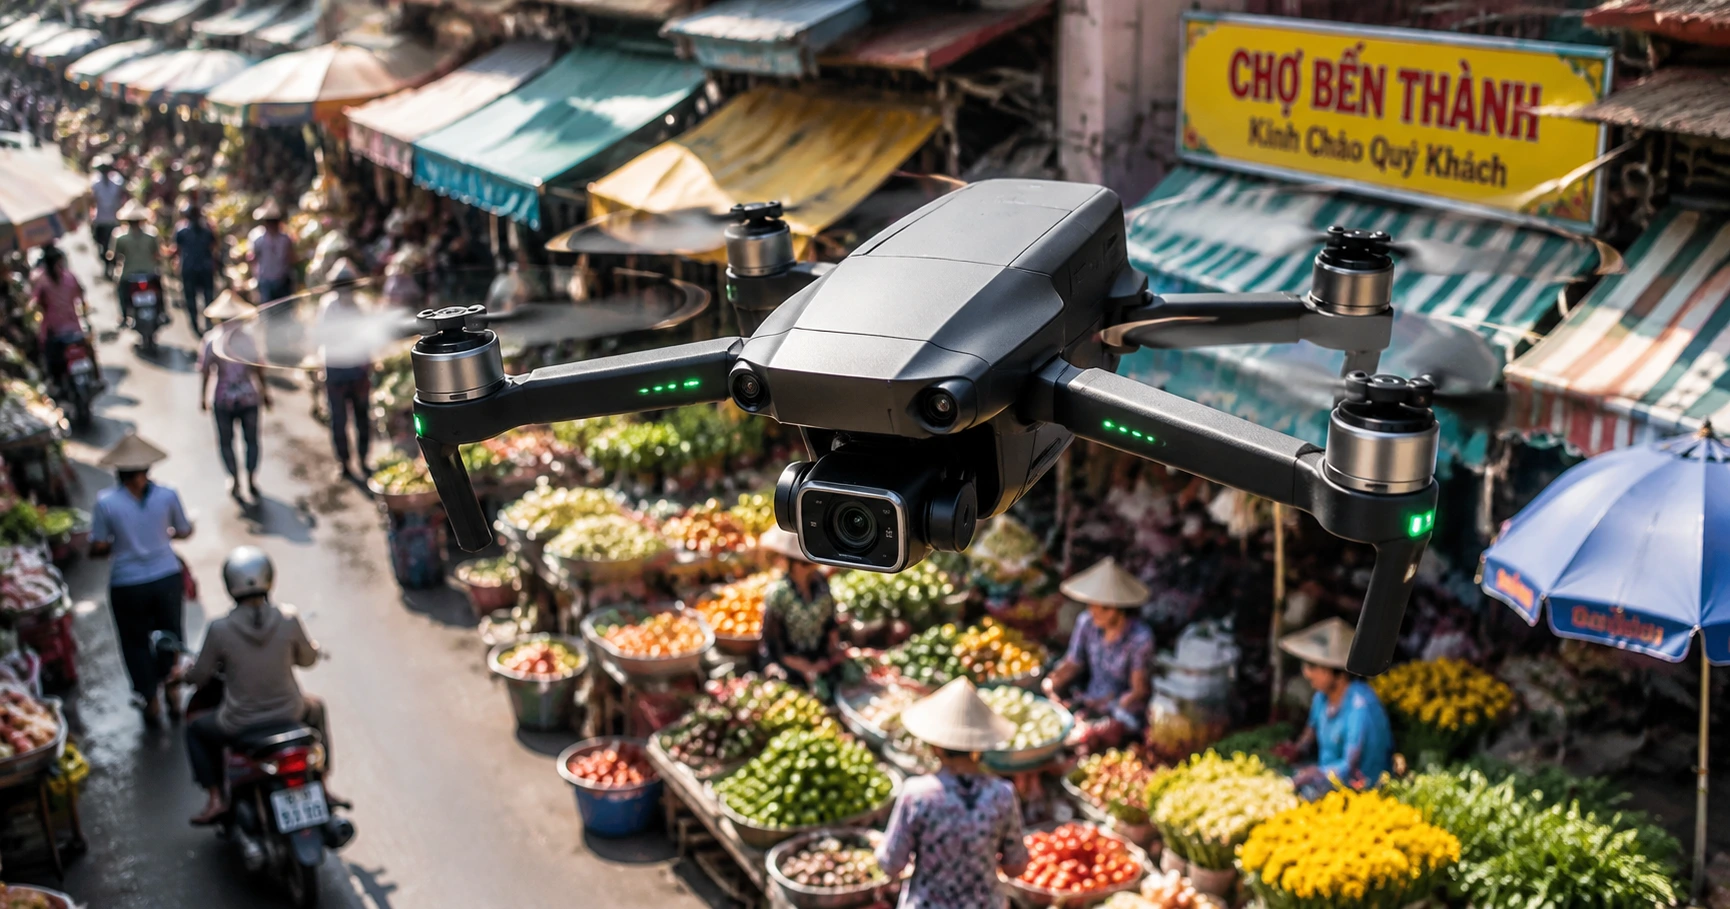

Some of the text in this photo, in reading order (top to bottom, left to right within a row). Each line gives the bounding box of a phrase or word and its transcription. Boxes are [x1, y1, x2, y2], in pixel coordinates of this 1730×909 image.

[1229, 41, 1541, 143] CHỢ BẾN THÀNH
[1424, 143, 1507, 188] Khách
